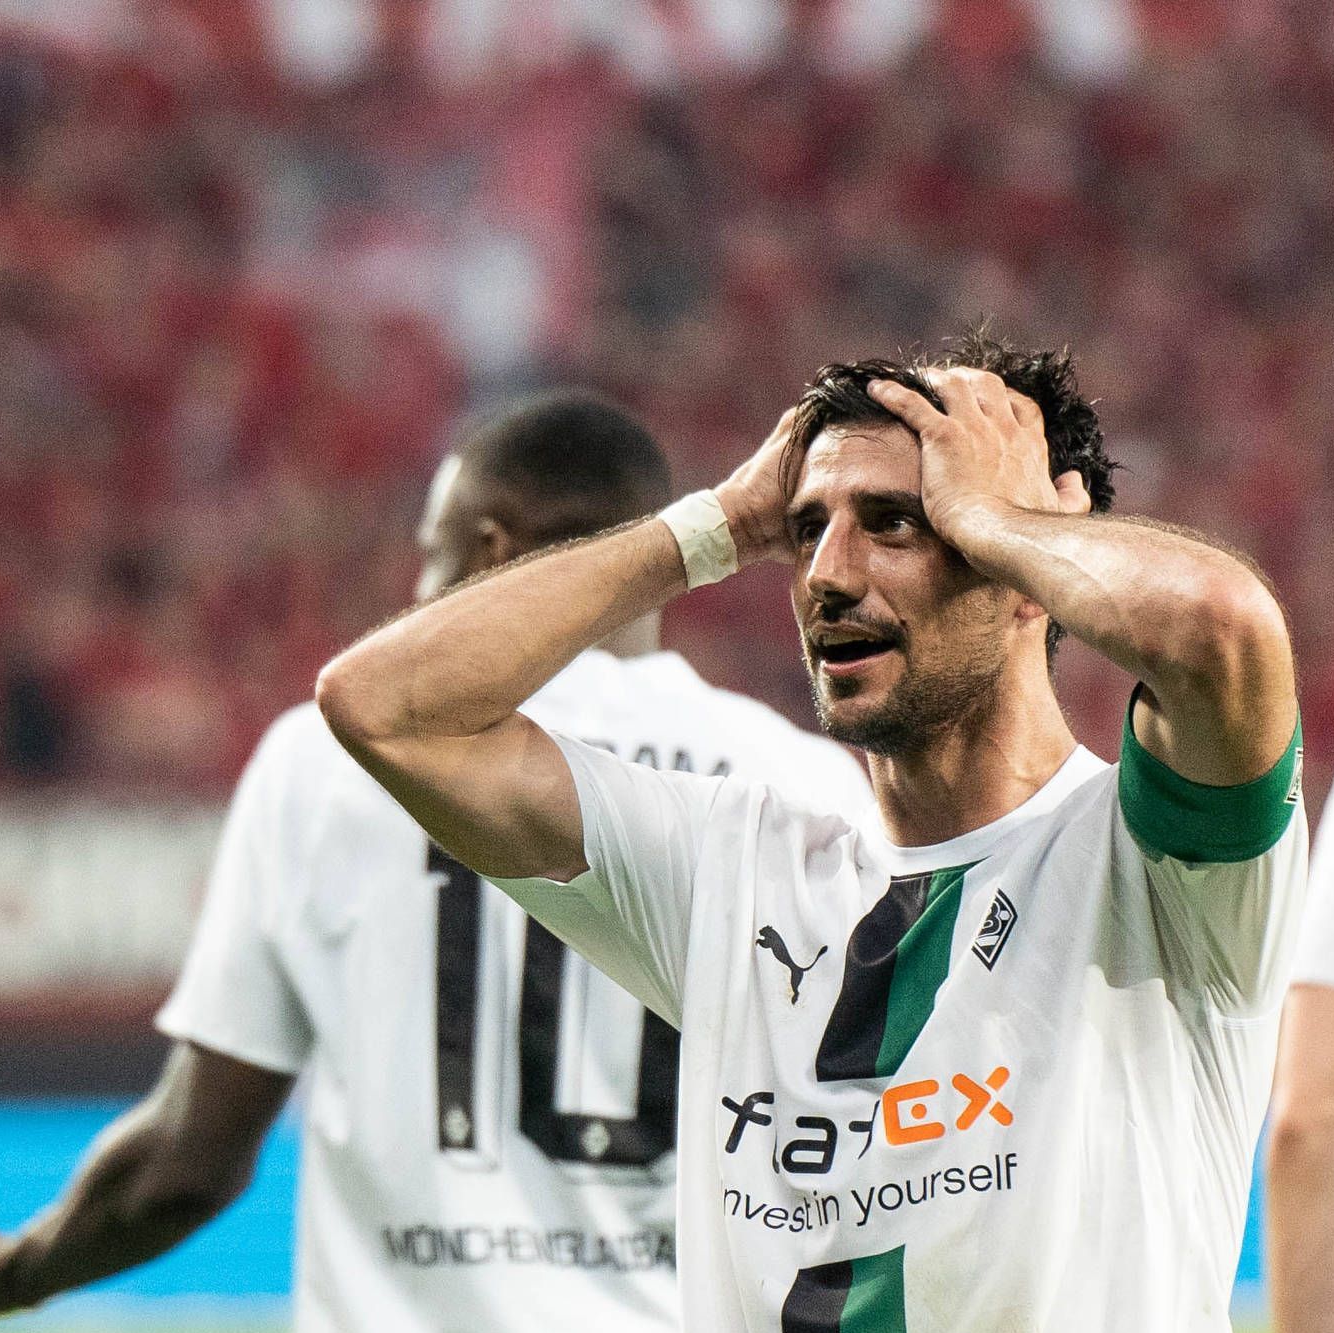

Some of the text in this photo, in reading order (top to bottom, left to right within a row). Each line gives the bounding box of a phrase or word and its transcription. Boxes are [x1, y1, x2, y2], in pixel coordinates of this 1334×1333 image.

[428, 836, 680, 1168] 10
[723, 1152, 1017, 1233] nvest in yourself
